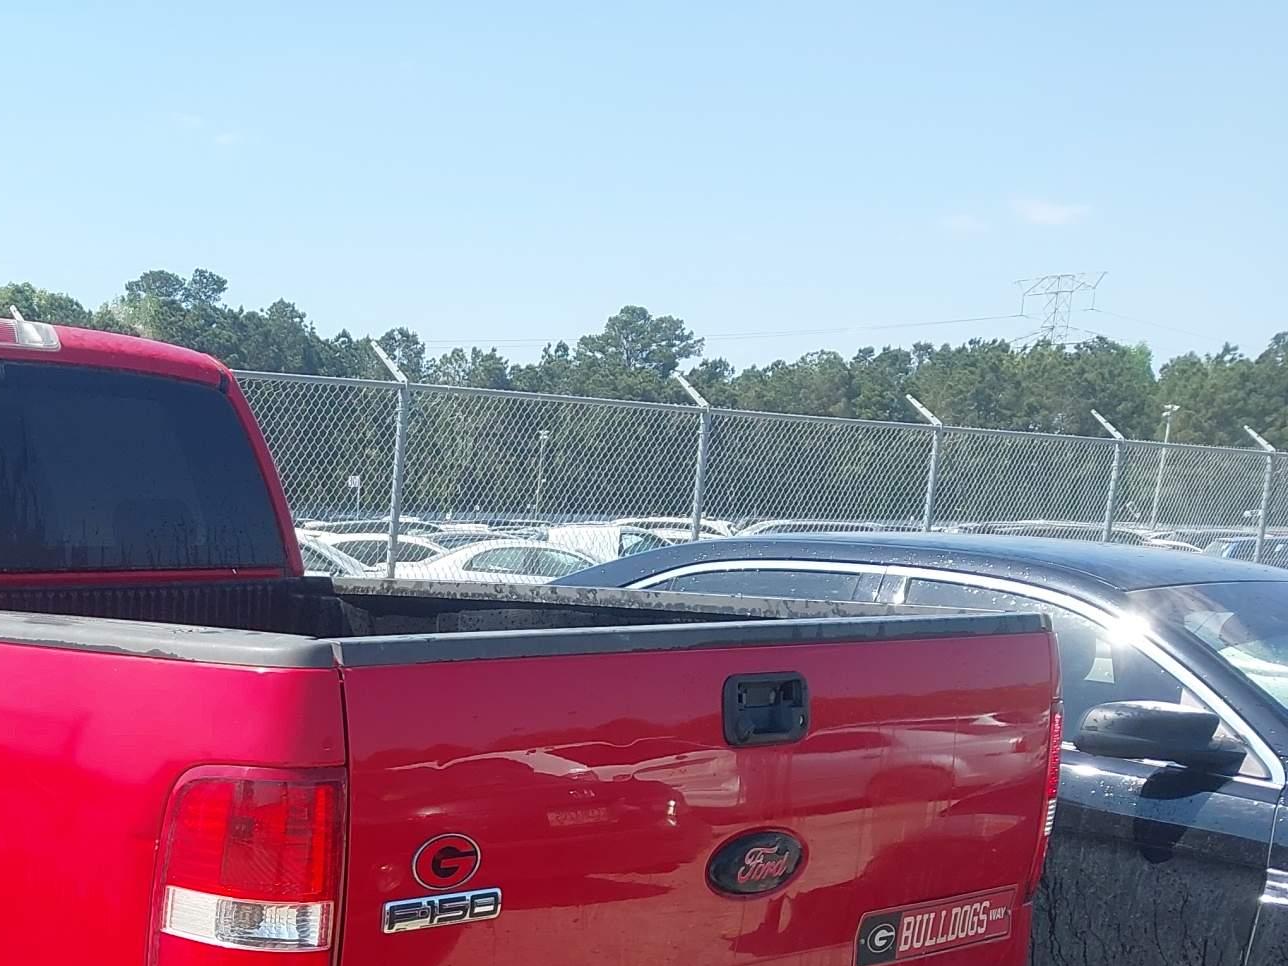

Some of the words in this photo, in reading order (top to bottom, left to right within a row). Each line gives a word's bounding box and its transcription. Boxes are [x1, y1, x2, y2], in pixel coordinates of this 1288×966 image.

[416, 835, 478, 888] G
[736, 845, 790, 884] Ford
[898, 900, 991, 952] BULLDOGS
[989, 906, 1007, 921] WAY
